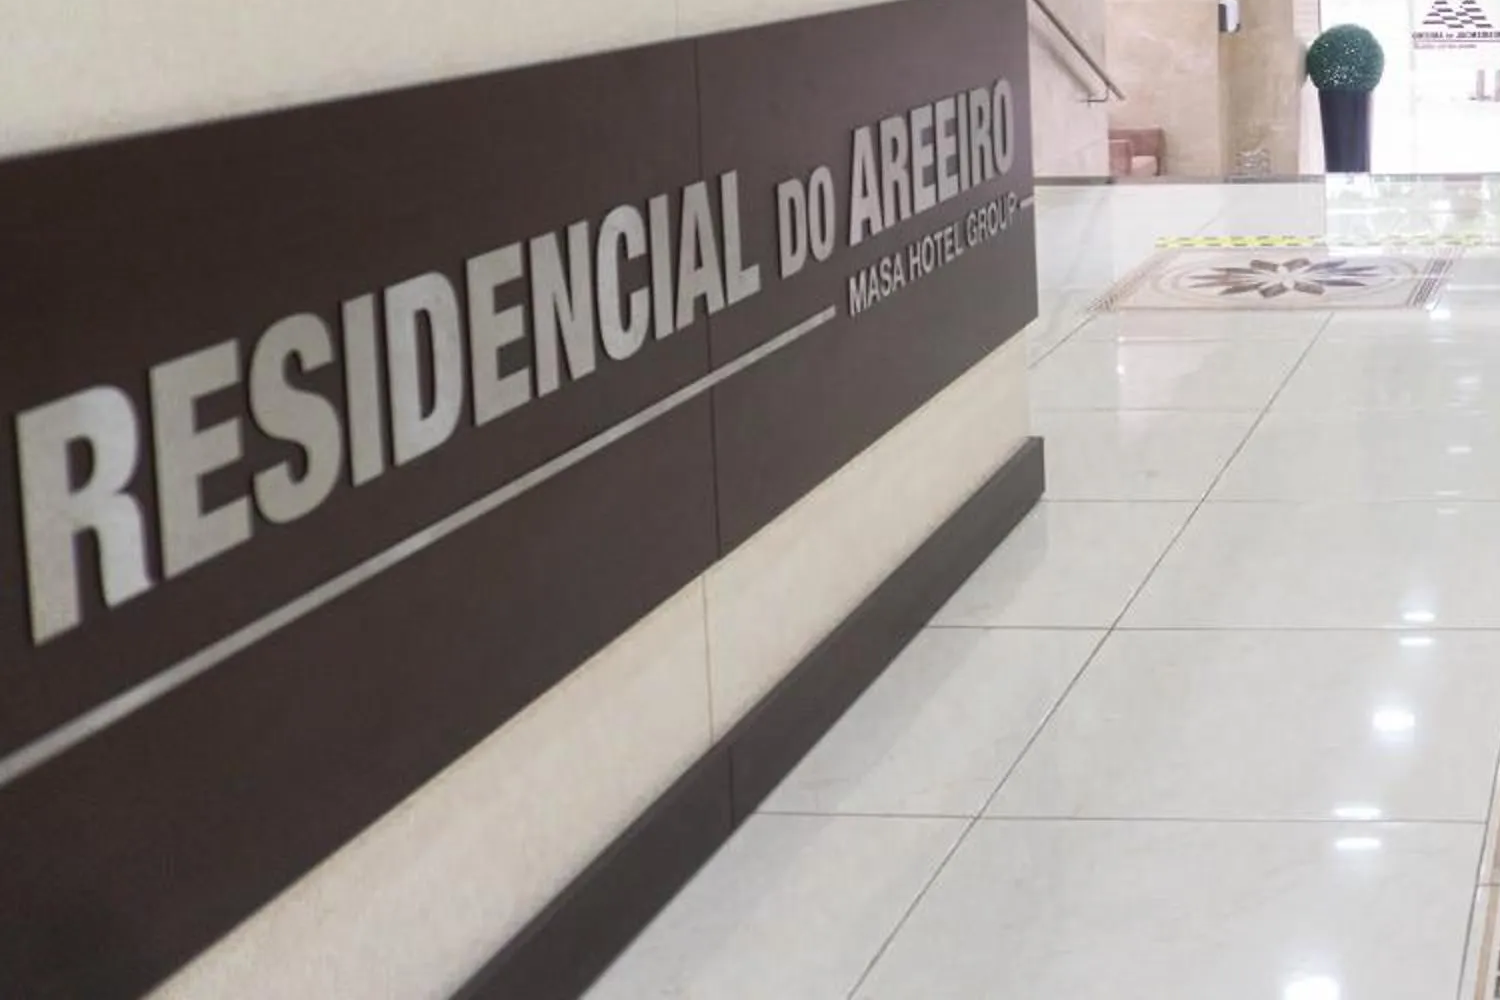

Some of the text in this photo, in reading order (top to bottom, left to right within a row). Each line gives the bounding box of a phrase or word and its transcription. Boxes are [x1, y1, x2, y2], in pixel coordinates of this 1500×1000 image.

[16, 77, 1015, 647] RESIDENCIAL DO AREEIRO
[849, 190, 1019, 317] MASA HOTEL GROUP
